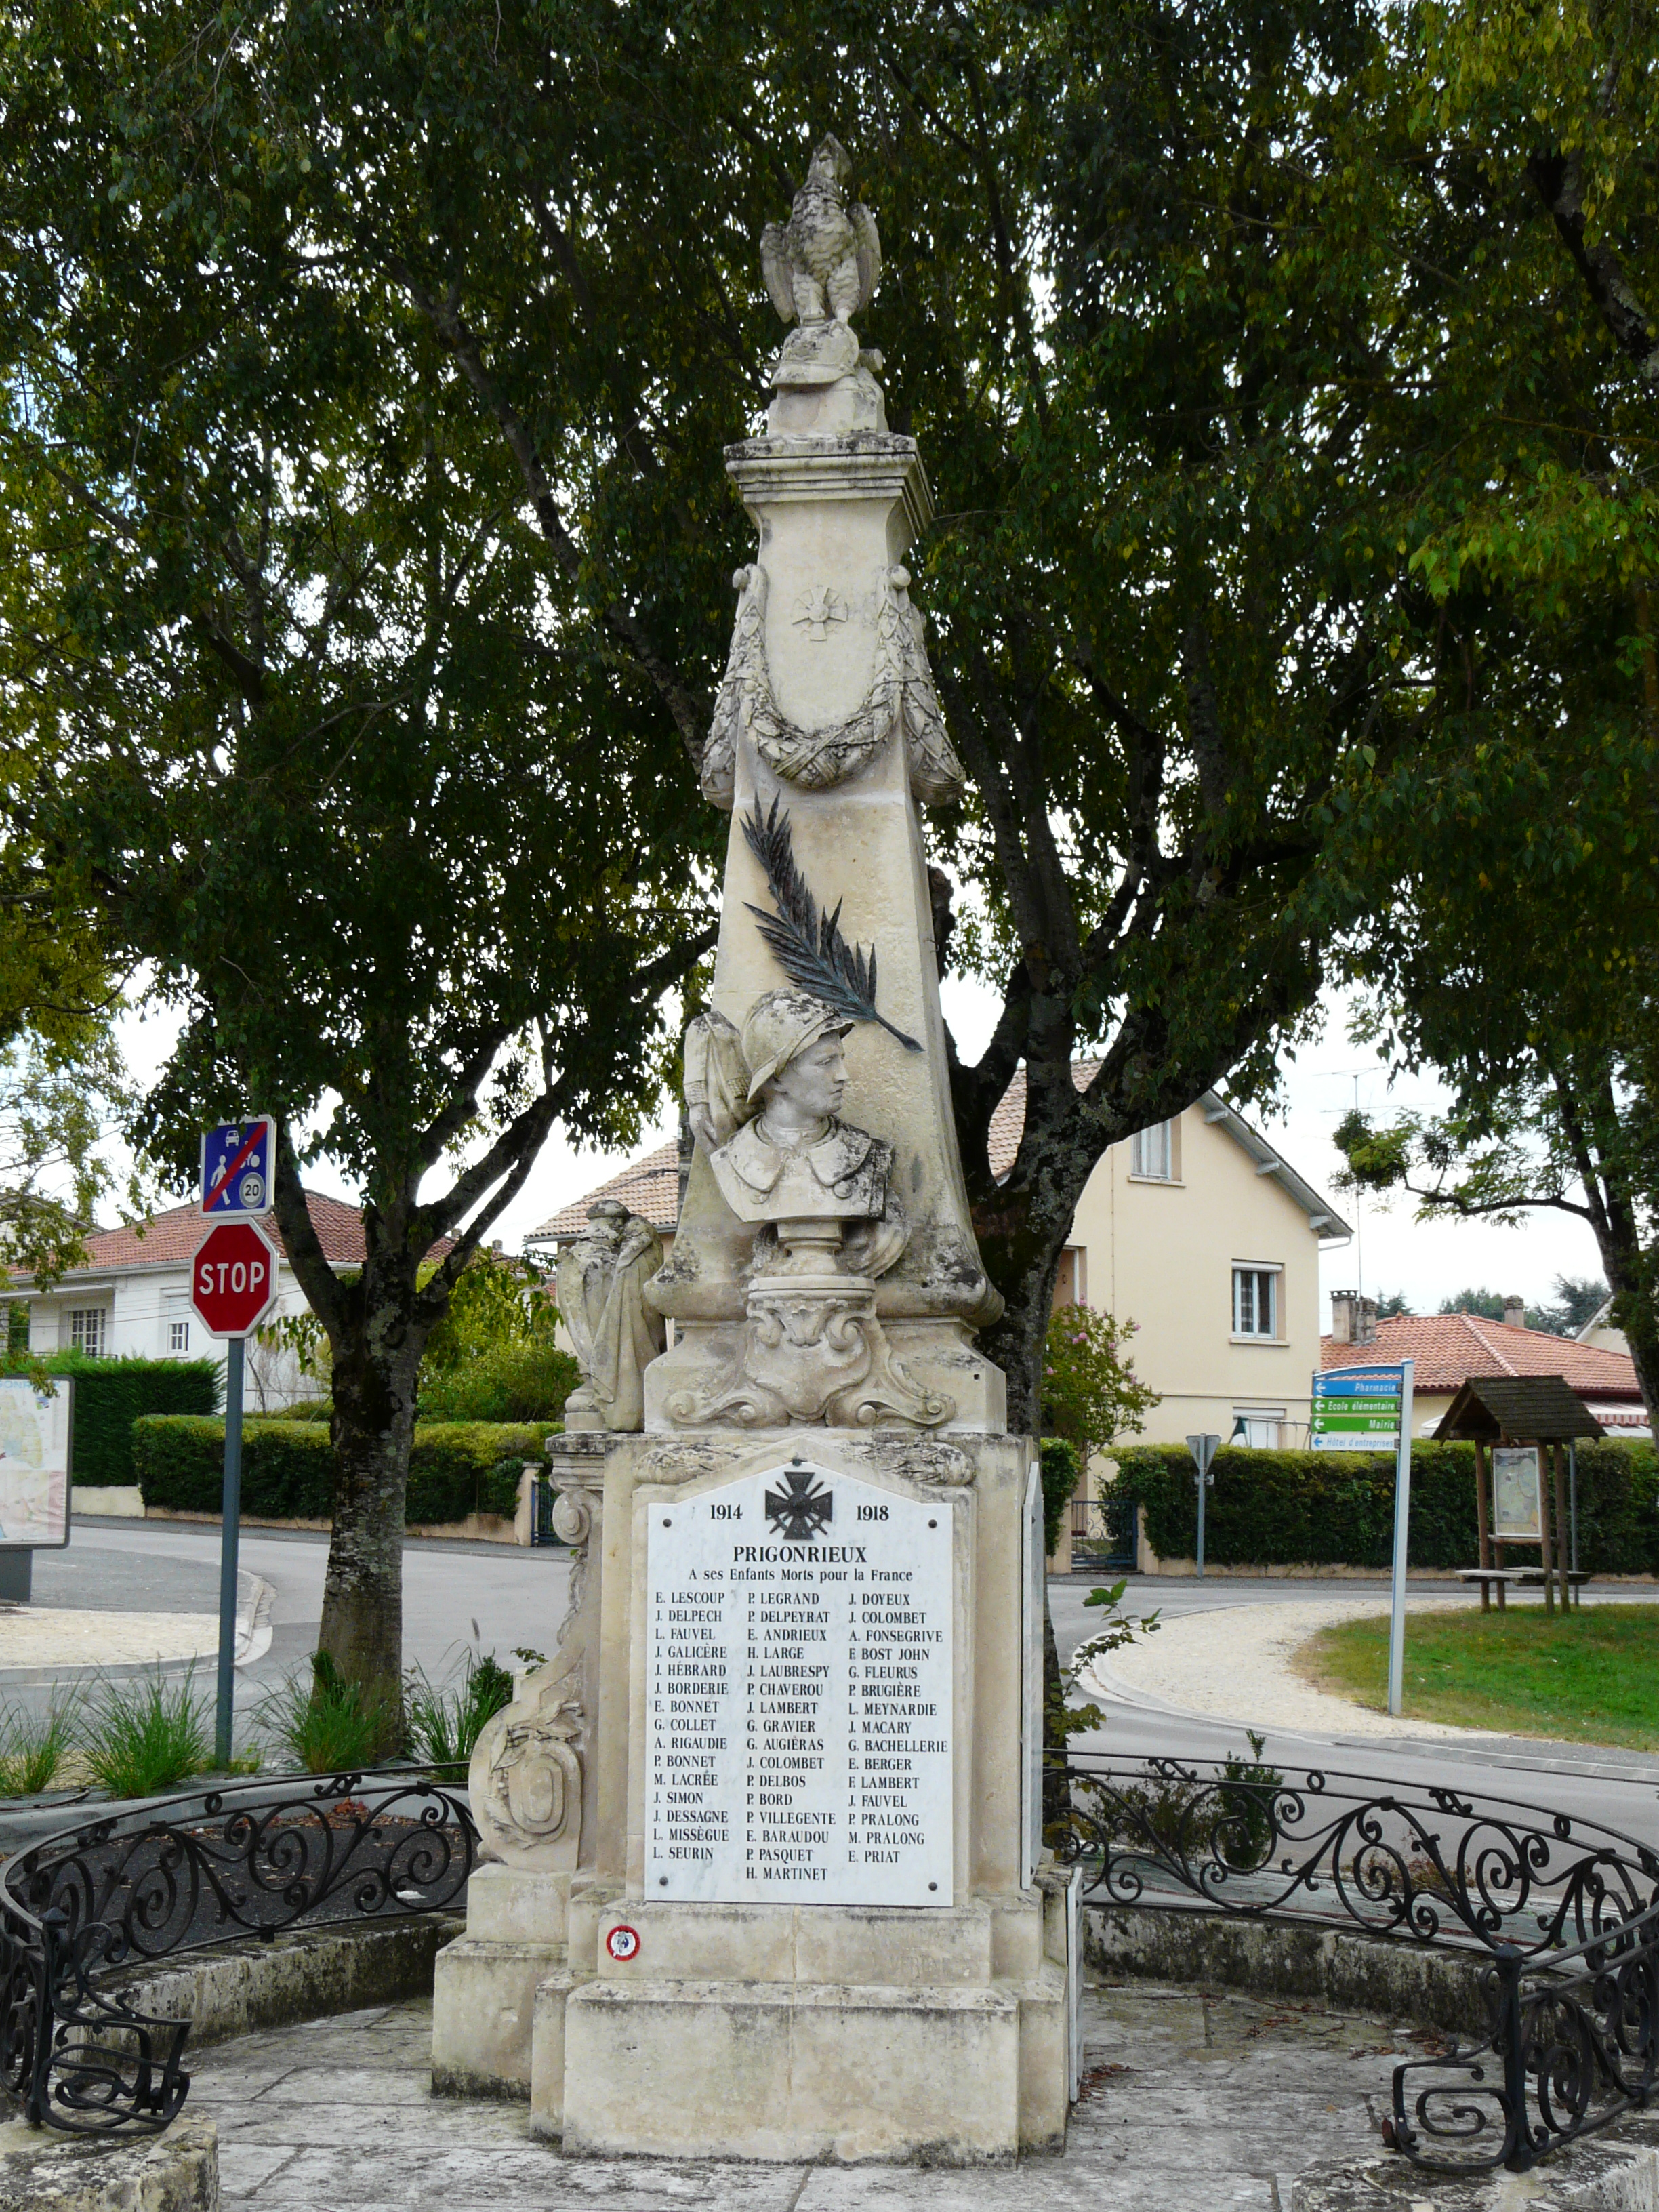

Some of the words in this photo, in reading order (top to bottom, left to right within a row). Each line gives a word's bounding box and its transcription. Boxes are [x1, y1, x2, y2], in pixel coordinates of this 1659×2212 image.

[245, 1185, 260, 1197] 20
[199, 1261, 264, 1295] STOP
[1355, 1383, 1395, 1392] Pharmacie
[1328, 1401, 1348, 1410] Ecole
[1352, 1401, 1395, 1410] élémentaire
[1369, 1420, 1395, 1429] Mairie
[1327, 1438, 1345, 1446] Hôtel
[1349, 1438, 1393, 1448] d'entreprises
[711, 1504, 743, 1520] 1914
[857, 1505, 889, 1521] 1918
[733, 1547, 867, 1563] PRIGONRIEUX
[689, 1568, 697, 1580] A
[703, 1570, 723, 1580] ses
[730, 1567, 775, 1580] Enfants
[781, 1569, 813, 1580] Morts
[820, 1571, 848, 1584] pour
[855, 1568, 864, 1581] la
[871, 1570, 912, 1581] France
[656, 1592, 665, 1603] E.
[672, 1592, 724, 1603] LESCOUP
[748, 1593, 755, 1604] P.
[761, 1593, 819, 1605] LEGRAND
[849, 1593, 856, 1605] J.
[863, 1593, 910, 1605] DOYEUX
[656, 1610, 662, 1621] J.
[669, 1610, 721, 1622] DELPECH
[748, 1611, 755, 1622] P.
[761, 1611, 830, 1623] DELPEYRAT
[848, 1612, 856, 1623] J.
[862, 1612, 926, 1624] COLOMBET
[656, 1628, 665, 1639] L.
[671, 1628, 715, 1640] FAUVEL
[748, 1629, 758, 1641] E.
[764, 1629, 826, 1641] ANDRIEUX
[849, 1630, 860, 1641] A.
[867, 1630, 943, 1642] FONSEGRIVE
[655, 1646, 661, 1658] J.
[748, 1647, 758, 1658] H.
[764, 1647, 804, 1659] LARGE
[849, 1648, 855, 1660] F.
[861, 1648, 892, 1660] BOST
[899, 1649, 929, 1660] JOHN
[655, 1664, 661, 1675] J.
[747, 1665, 754, 1677] J.
[760, 1665, 830, 1677] LAUBRESPY
[849, 1666, 859, 1678] G.
[865, 1666, 917, 1679] FLEURUS
[655, 1683, 661, 1694] J.
[668, 1683, 729, 1694] BORDERIE
[747, 1683, 754, 1695] P.
[760, 1683, 823, 1696] CHAVEROU
[849, 1684, 856, 1696] P.
[655, 1700, 664, 1712] E.
[671, 1700, 719, 1713] BONNET
[747, 1702, 754, 1713] J.
[760, 1702, 818, 1714] LAMBERT
[849, 1703, 859, 1715] L.
[865, 1703, 937, 1715] MEYNARDIE
[655, 1719, 664, 1730] G.
[670, 1719, 716, 1731] COLLET
[747, 1719, 757, 1732] G.
[764, 1720, 815, 1732] GRAVIER
[848, 1721, 856, 1733] J.
[862, 1721, 911, 1734] MACARY
[655, 1737, 665, 1748] A.
[672, 1737, 727, 1749] RIGAUDIE
[747, 1738, 757, 1750] G.
[848, 1740, 859, 1751] G.
[865, 1740, 947, 1752] BACHELLERIE
[655, 1755, 661, 1767] P.
[667, 1755, 716, 1767] BONNET
[747, 1757, 754, 1768] J.
[760, 1757, 824, 1769] COLOMBET
[849, 1758, 859, 1769] E.
[865, 1758, 912, 1770] BERGER
[655, 1774, 665, 1785] M.
[747, 1775, 754, 1786] P.
[760, 1775, 806, 1787] DELBOS
[849, 1776, 855, 1788] F.
[861, 1776, 919, 1788] LAMBERT
[654, 1792, 661, 1803] J.
[667, 1792, 703, 1803] SIMON
[747, 1793, 754, 1805] P.
[760, 1793, 792, 1805] BORD
[848, 1795, 855, 1807] J.
[862, 1795, 907, 1807] FAUVEL
[654, 1810, 660, 1822] J.
[667, 1810, 728, 1823] DESSAGNE
[747, 1811, 754, 1823] P.
[760, 1811, 836, 1824] VILLEGENTE
[849, 1814, 855, 1824] P.
[862, 1814, 919, 1826] PRALONG
[654, 1828, 663, 1840] L.
[747, 1830, 756, 1841] E.
[763, 1830, 829, 1843] BARAUDOU
[849, 1832, 860, 1843] M.
[867, 1832, 924, 1845] PRALONG
[653, 1847, 663, 1858] L.
[669, 1847, 713, 1860] SEURIN
[747, 1849, 753, 1860] P.
[760, 1849, 813, 1864] PASQUET
[848, 1851, 858, 1862] E.
[865, 1851, 900, 1863] PRIAT
[747, 1867, 757, 1879] H.
[764, 1867, 827, 1880] MARTINET
